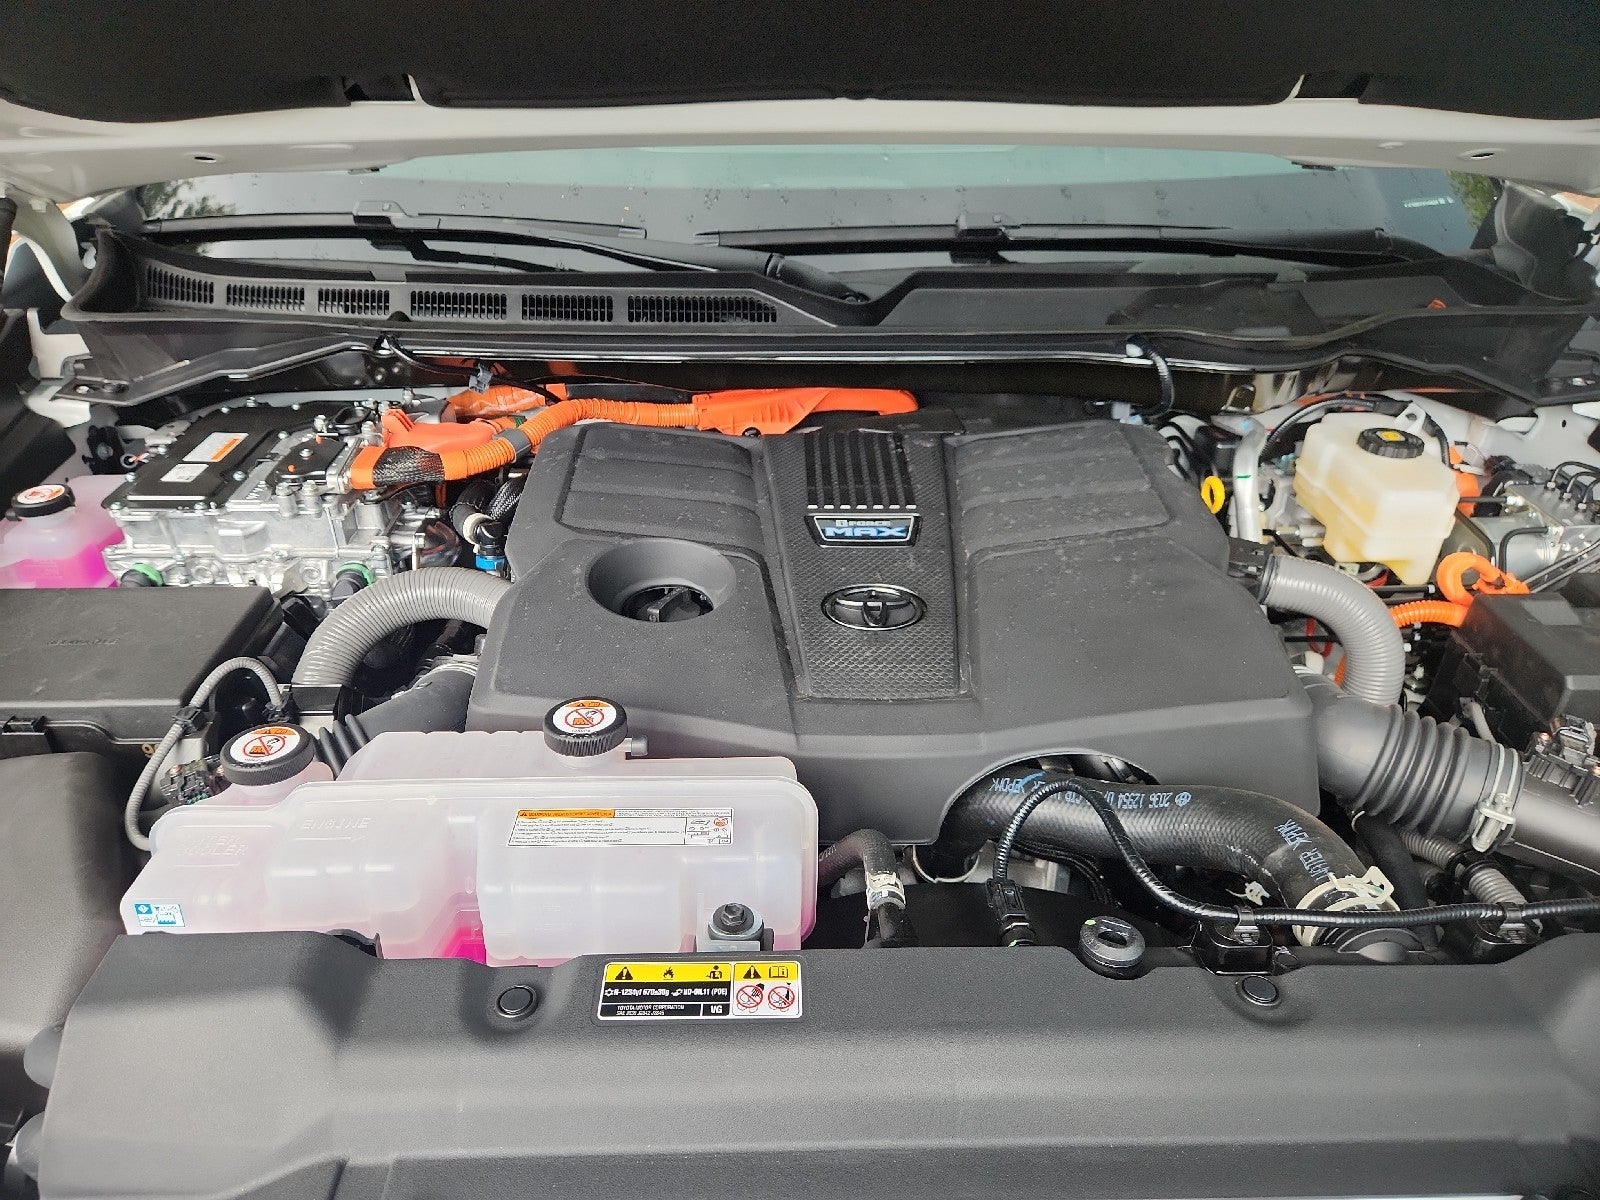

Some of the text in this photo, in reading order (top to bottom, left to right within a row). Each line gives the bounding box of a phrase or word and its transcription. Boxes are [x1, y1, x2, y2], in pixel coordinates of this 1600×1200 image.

[825, 526, 906, 537] MAX
[711, 987, 728, 997] (POE)
[710, 1005, 723, 1014] VG
